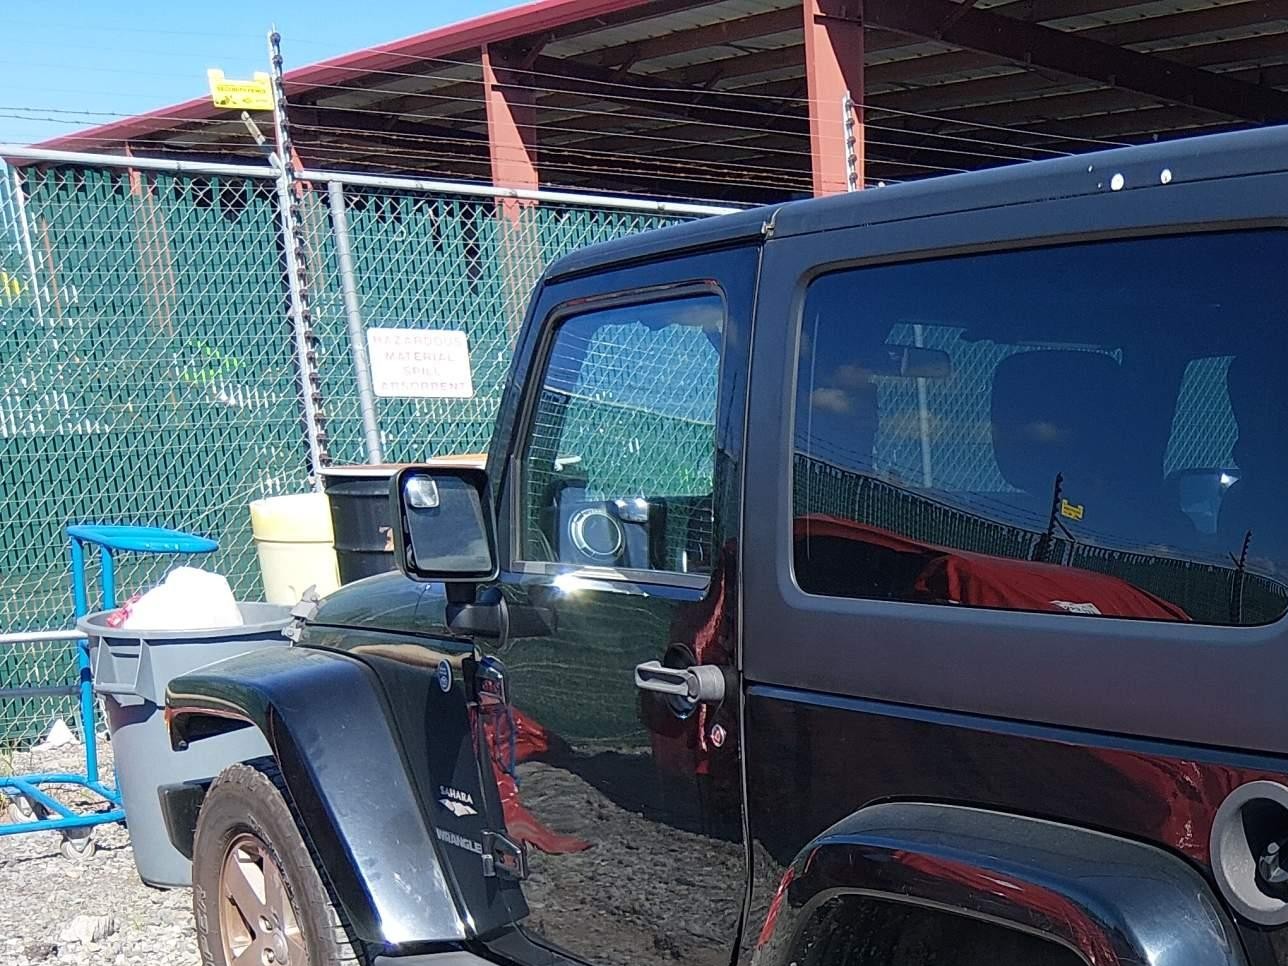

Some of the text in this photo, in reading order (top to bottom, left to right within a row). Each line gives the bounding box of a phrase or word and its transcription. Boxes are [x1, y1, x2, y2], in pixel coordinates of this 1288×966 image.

[384, 351, 456, 362] MATERIAL
[402, 366, 440, 377] SPILL
[440, 785, 474, 805] SAHARA
[435, 827, 483, 854] WRANGLE
